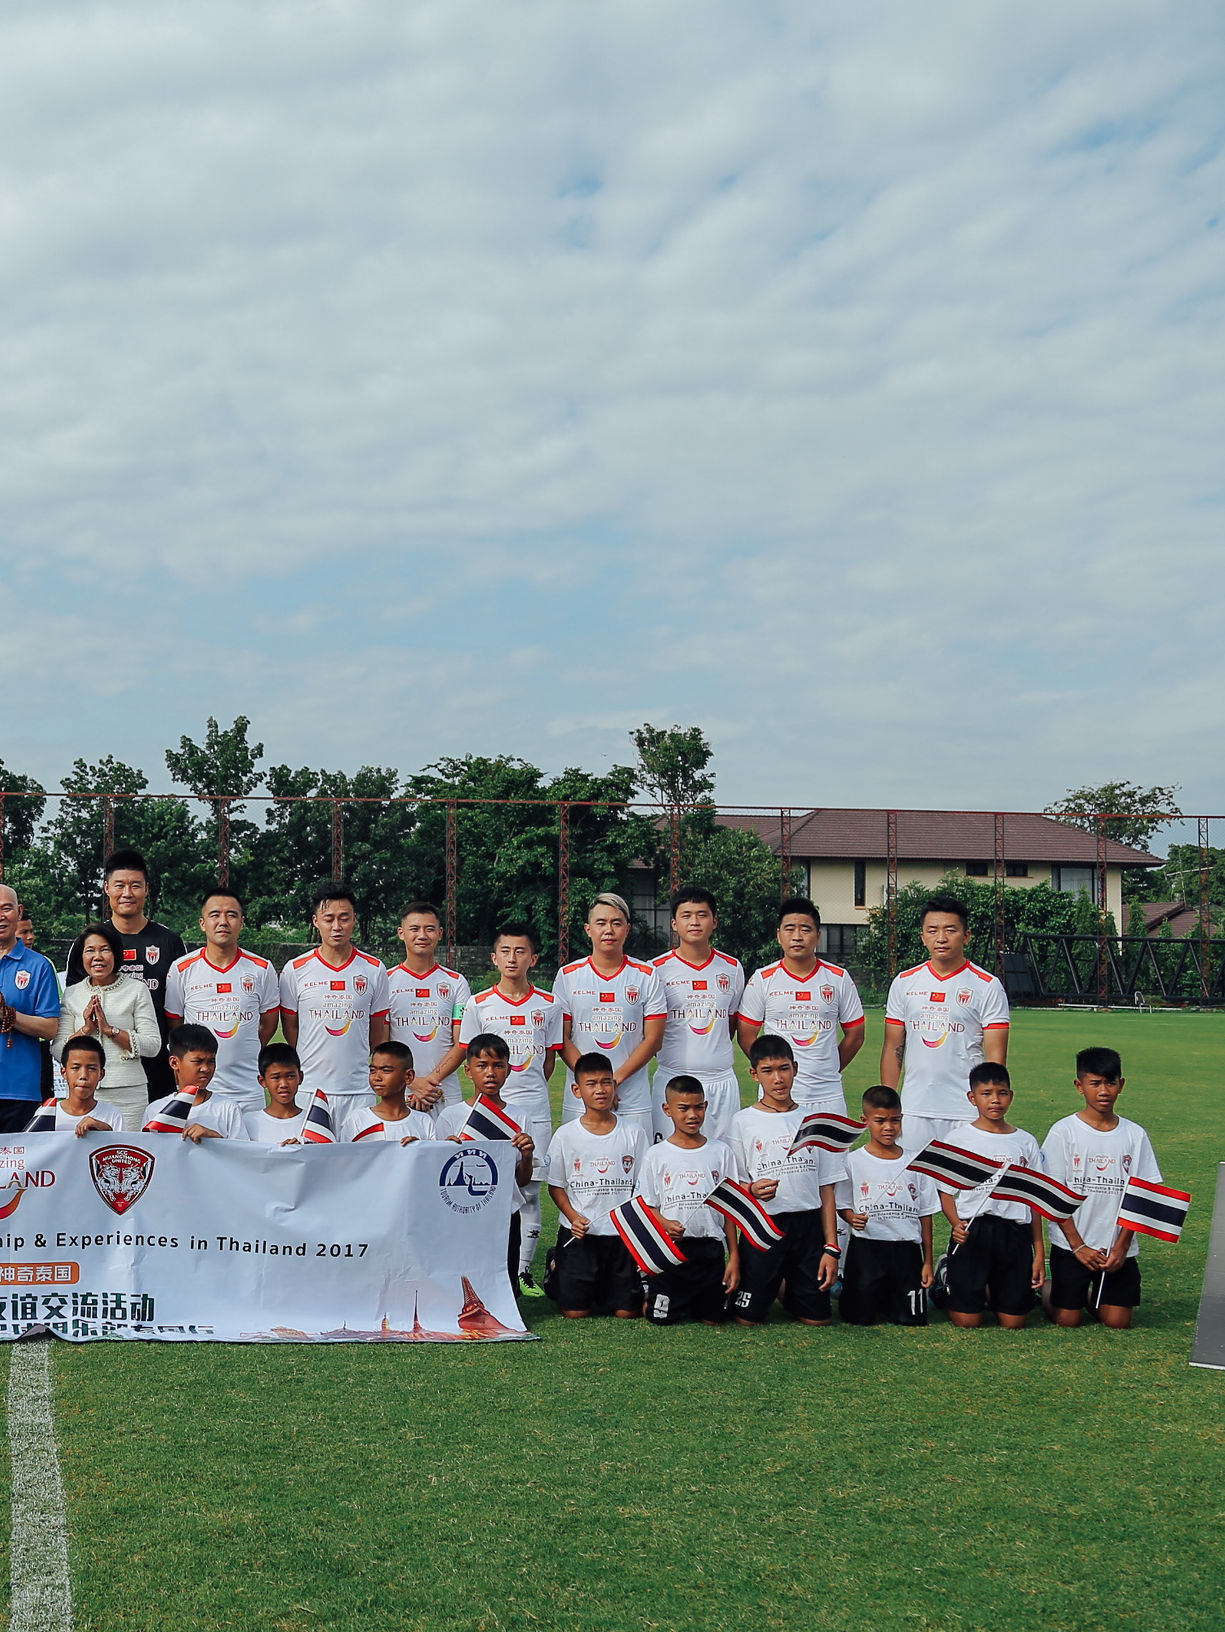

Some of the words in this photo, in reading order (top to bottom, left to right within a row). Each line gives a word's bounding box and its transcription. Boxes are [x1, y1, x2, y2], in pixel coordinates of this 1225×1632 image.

[196, 1011, 253, 1021] THAILAND
[309, 1009, 365, 1020] THAILAND
[671, 1009, 727, 1019] THAILAND
[396, 1016, 450, 1026] THAILAND
[775, 1019, 832, 1030] THAILAND
[909, 1020, 966, 1032] THAILAND
[578, 1022, 636, 1032] THAILAND
[510, 1045, 544, 1055] ILAND
[34, 1233, 47, 1248] &
[56, 1230, 179, 1249] Experiences
[189, 1235, 208, 1251] in
[216, 1236, 307, 1257] Thailand
[315, 1243, 369, 1258] 2017
[735, 1291, 752, 1308] 25
[907, 1288, 923, 1315] 11
